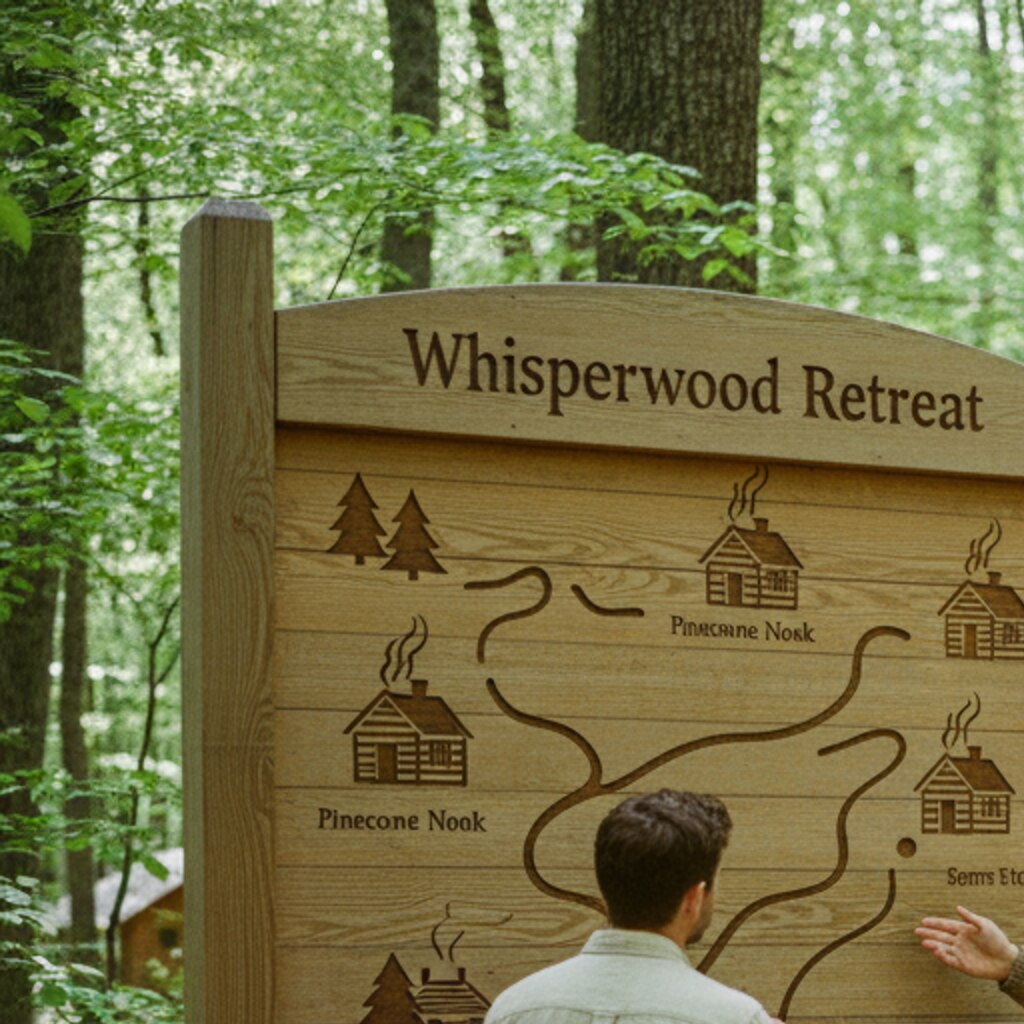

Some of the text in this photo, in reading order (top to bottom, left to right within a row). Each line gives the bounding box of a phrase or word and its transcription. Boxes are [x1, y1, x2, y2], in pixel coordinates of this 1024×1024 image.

[402, 328, 985, 432] Whisperwood Retreat
[318, 807, 420, 831] Pinecone
